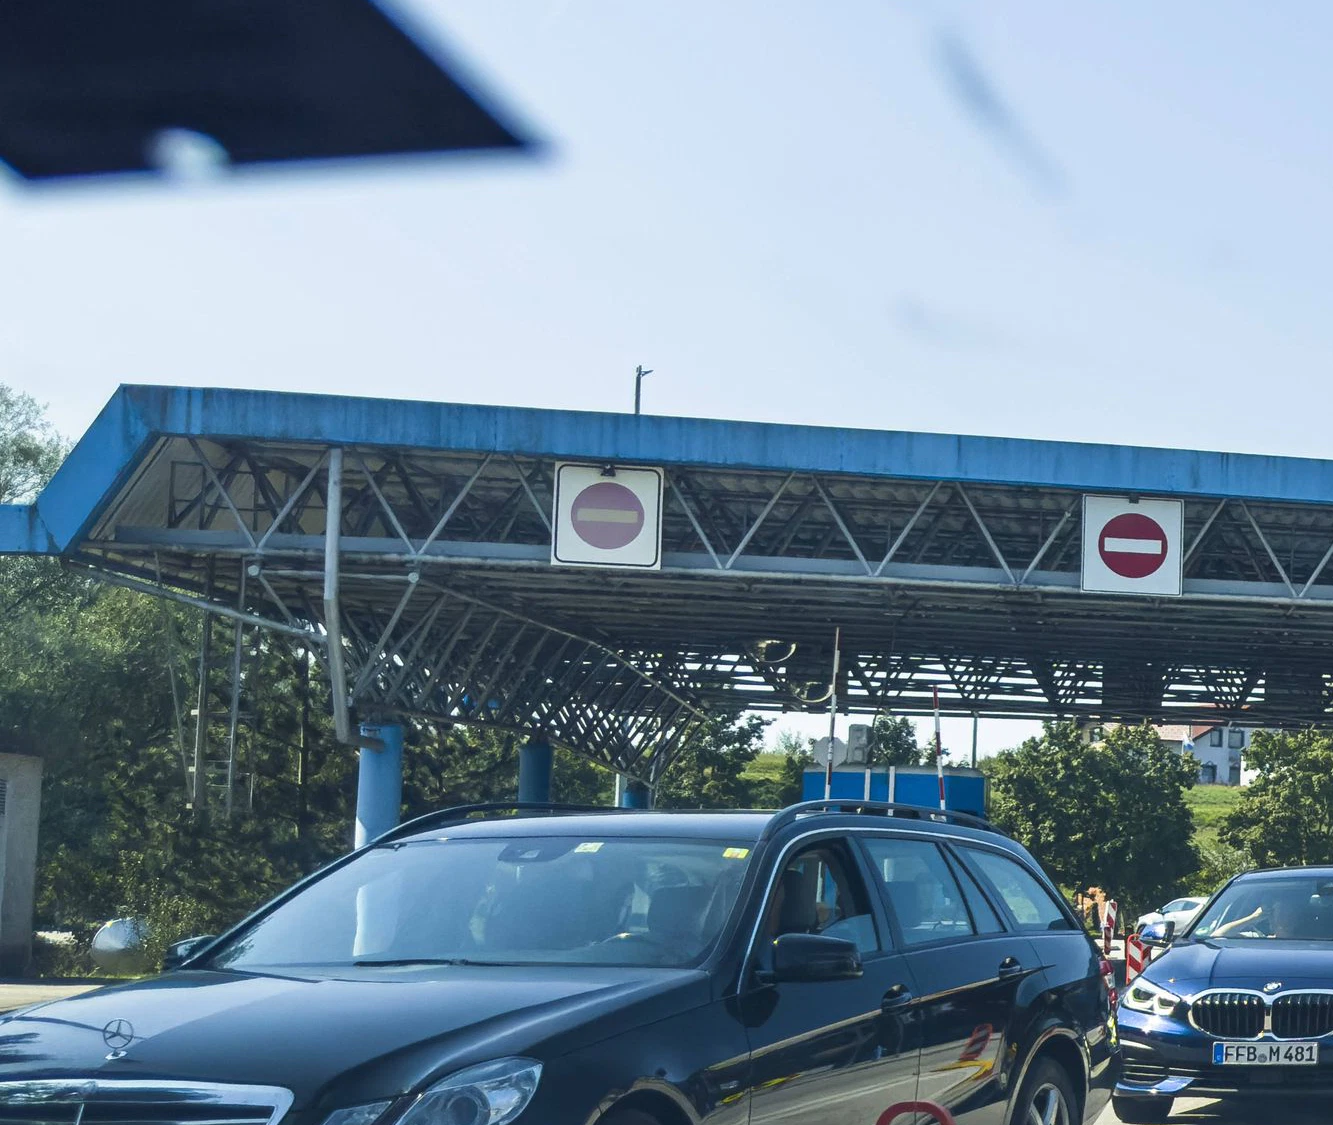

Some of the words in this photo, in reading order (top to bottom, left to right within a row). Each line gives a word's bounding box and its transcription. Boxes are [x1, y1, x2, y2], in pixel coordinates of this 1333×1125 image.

[1224, 1045, 1257, 1062] FFB
[1269, 1045, 1280, 1062] M
[1283, 1045, 1315, 1062] 481
